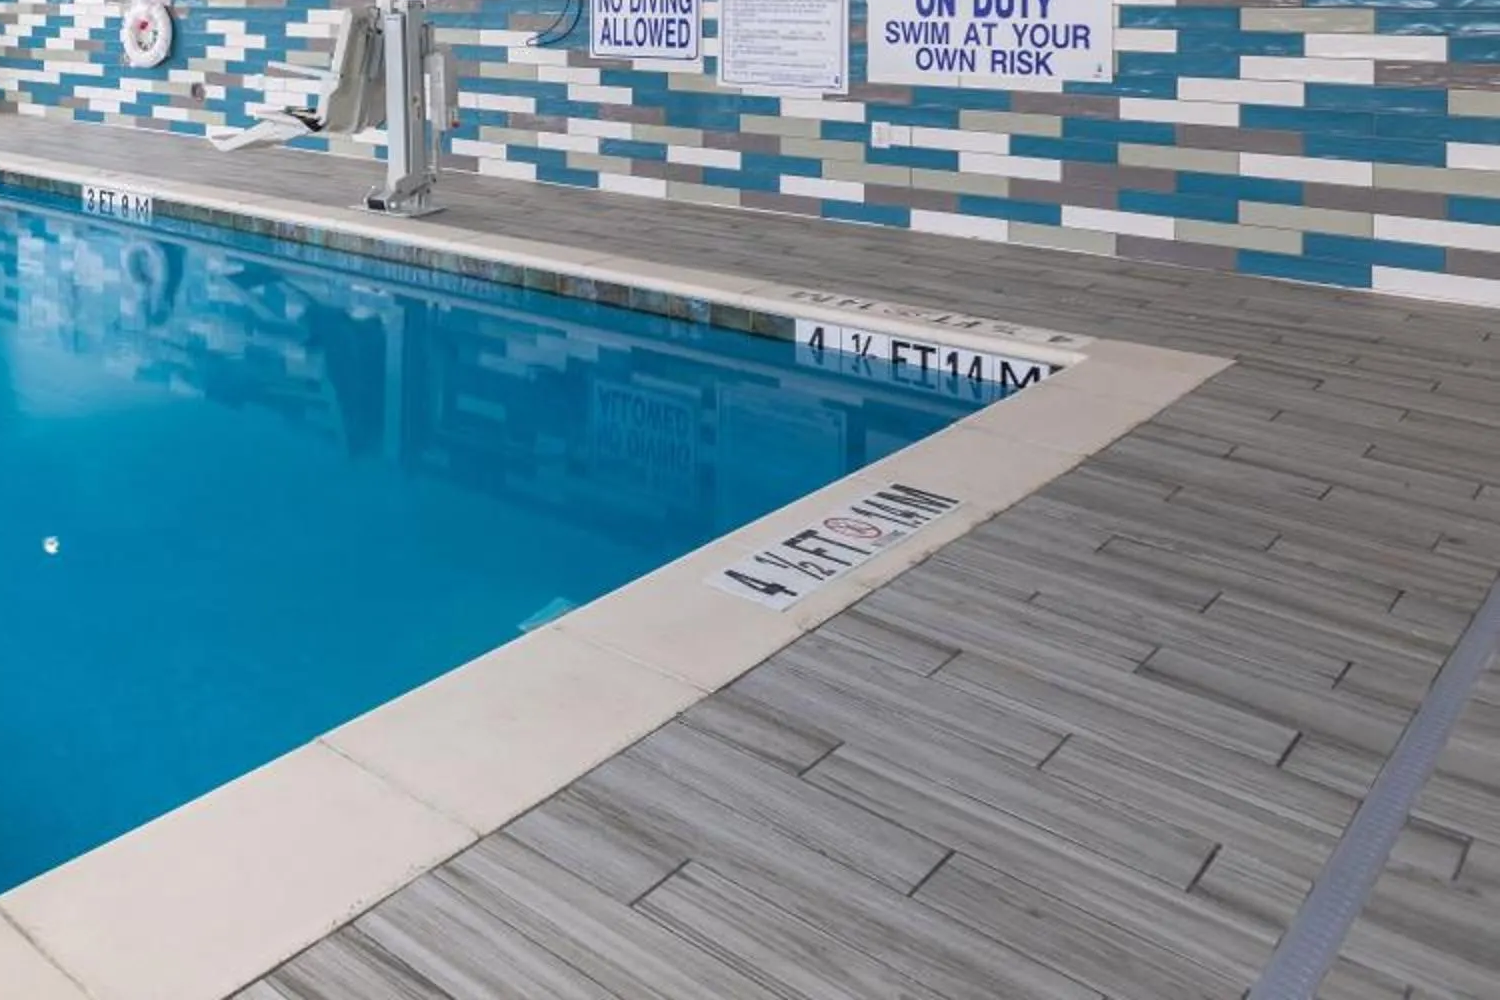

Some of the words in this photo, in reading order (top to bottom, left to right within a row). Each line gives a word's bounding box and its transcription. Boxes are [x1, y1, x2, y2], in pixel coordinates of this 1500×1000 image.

[600, 17, 691, 49] ALLOWED
[885, 21, 950, 45] SWIM
[964, 22, 998, 47] AT
[1012, 23, 1091, 50] YOUR
[915, 47, 976, 73] OWN
[991, 49, 1054, 77] RISK
[891, 340, 937, 370] FT
[724, 569, 798, 597] 4
[782, 529, 872, 567] FT
